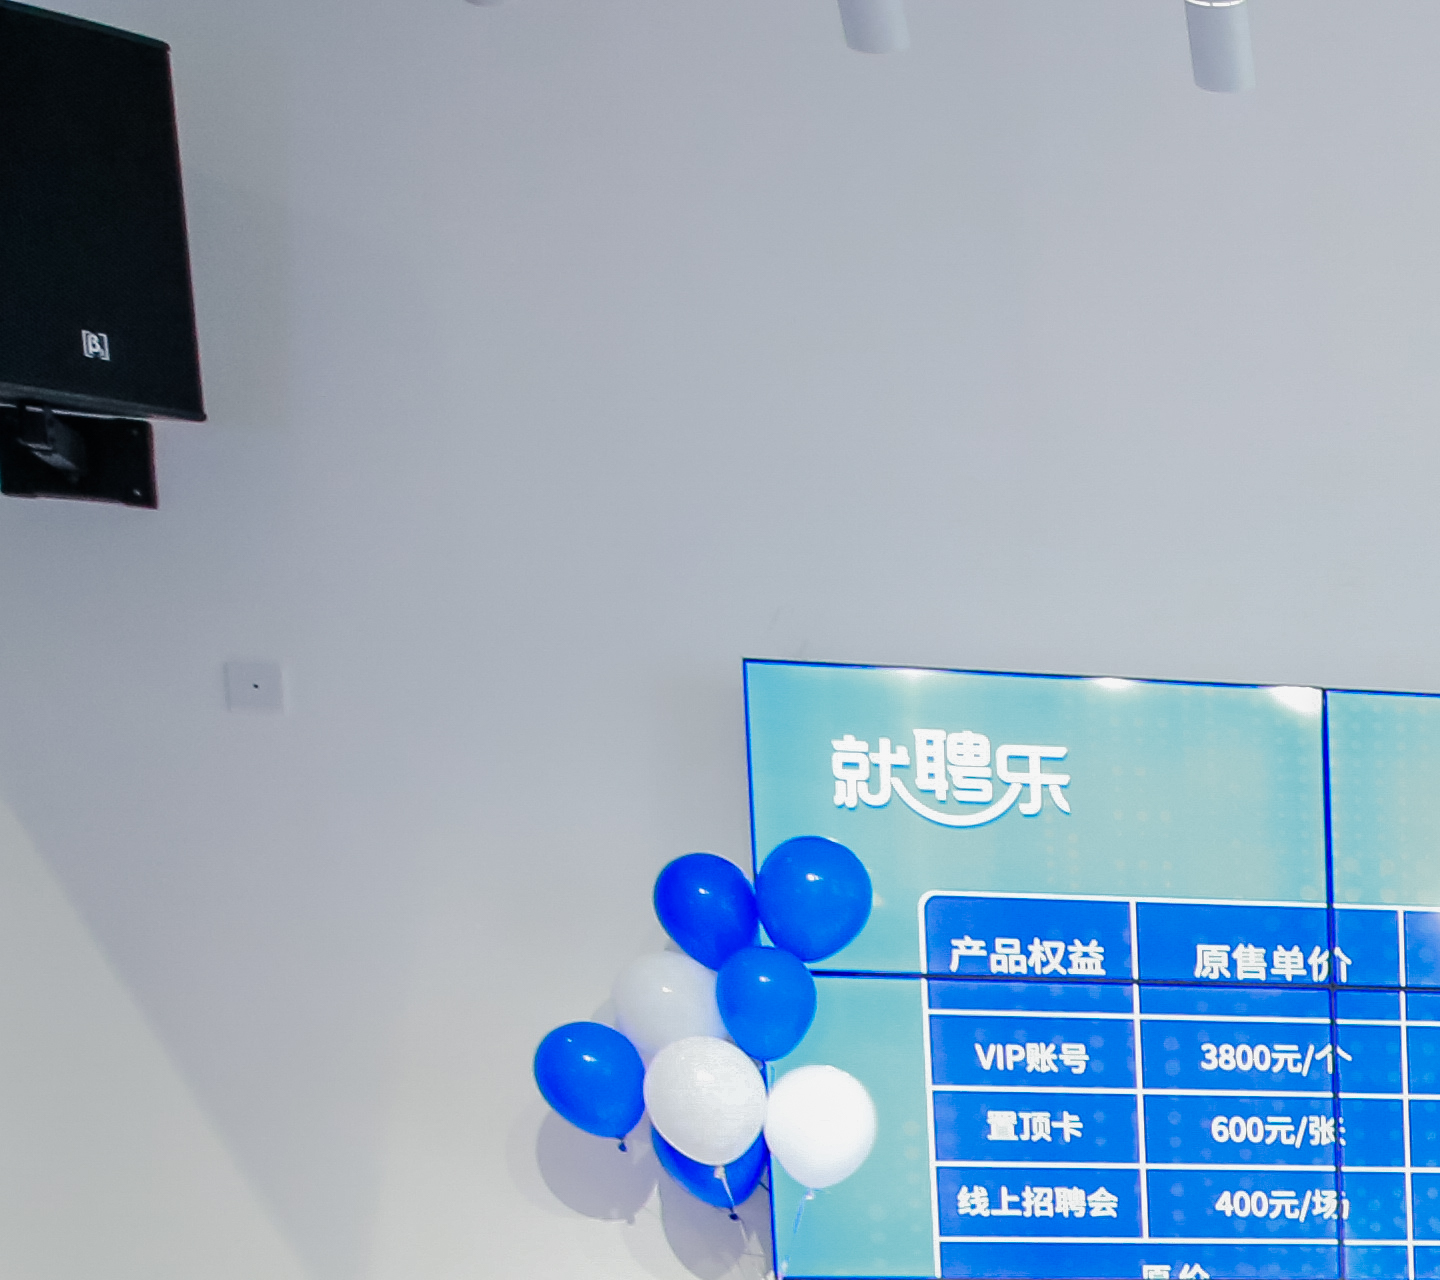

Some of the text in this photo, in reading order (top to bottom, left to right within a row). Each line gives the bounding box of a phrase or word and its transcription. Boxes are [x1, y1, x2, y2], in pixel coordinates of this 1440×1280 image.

[831, 728, 1071, 826] 就聘乐
[949, 937, 1106, 977] 产品权益
[1194, 943, 1352, 984] 原售单价
[975, 1042, 1090, 1074] VIP账号
[1200, 1042, 1352, 1077] 3800元/个
[986, 1110, 1083, 1143] 置顶卡
[1211, 1115, 1346, 1148] 600元/张
[957, 1185, 1119, 1219] 线上招聘会
[1214, 1189, 1349, 1222] 400元/场
